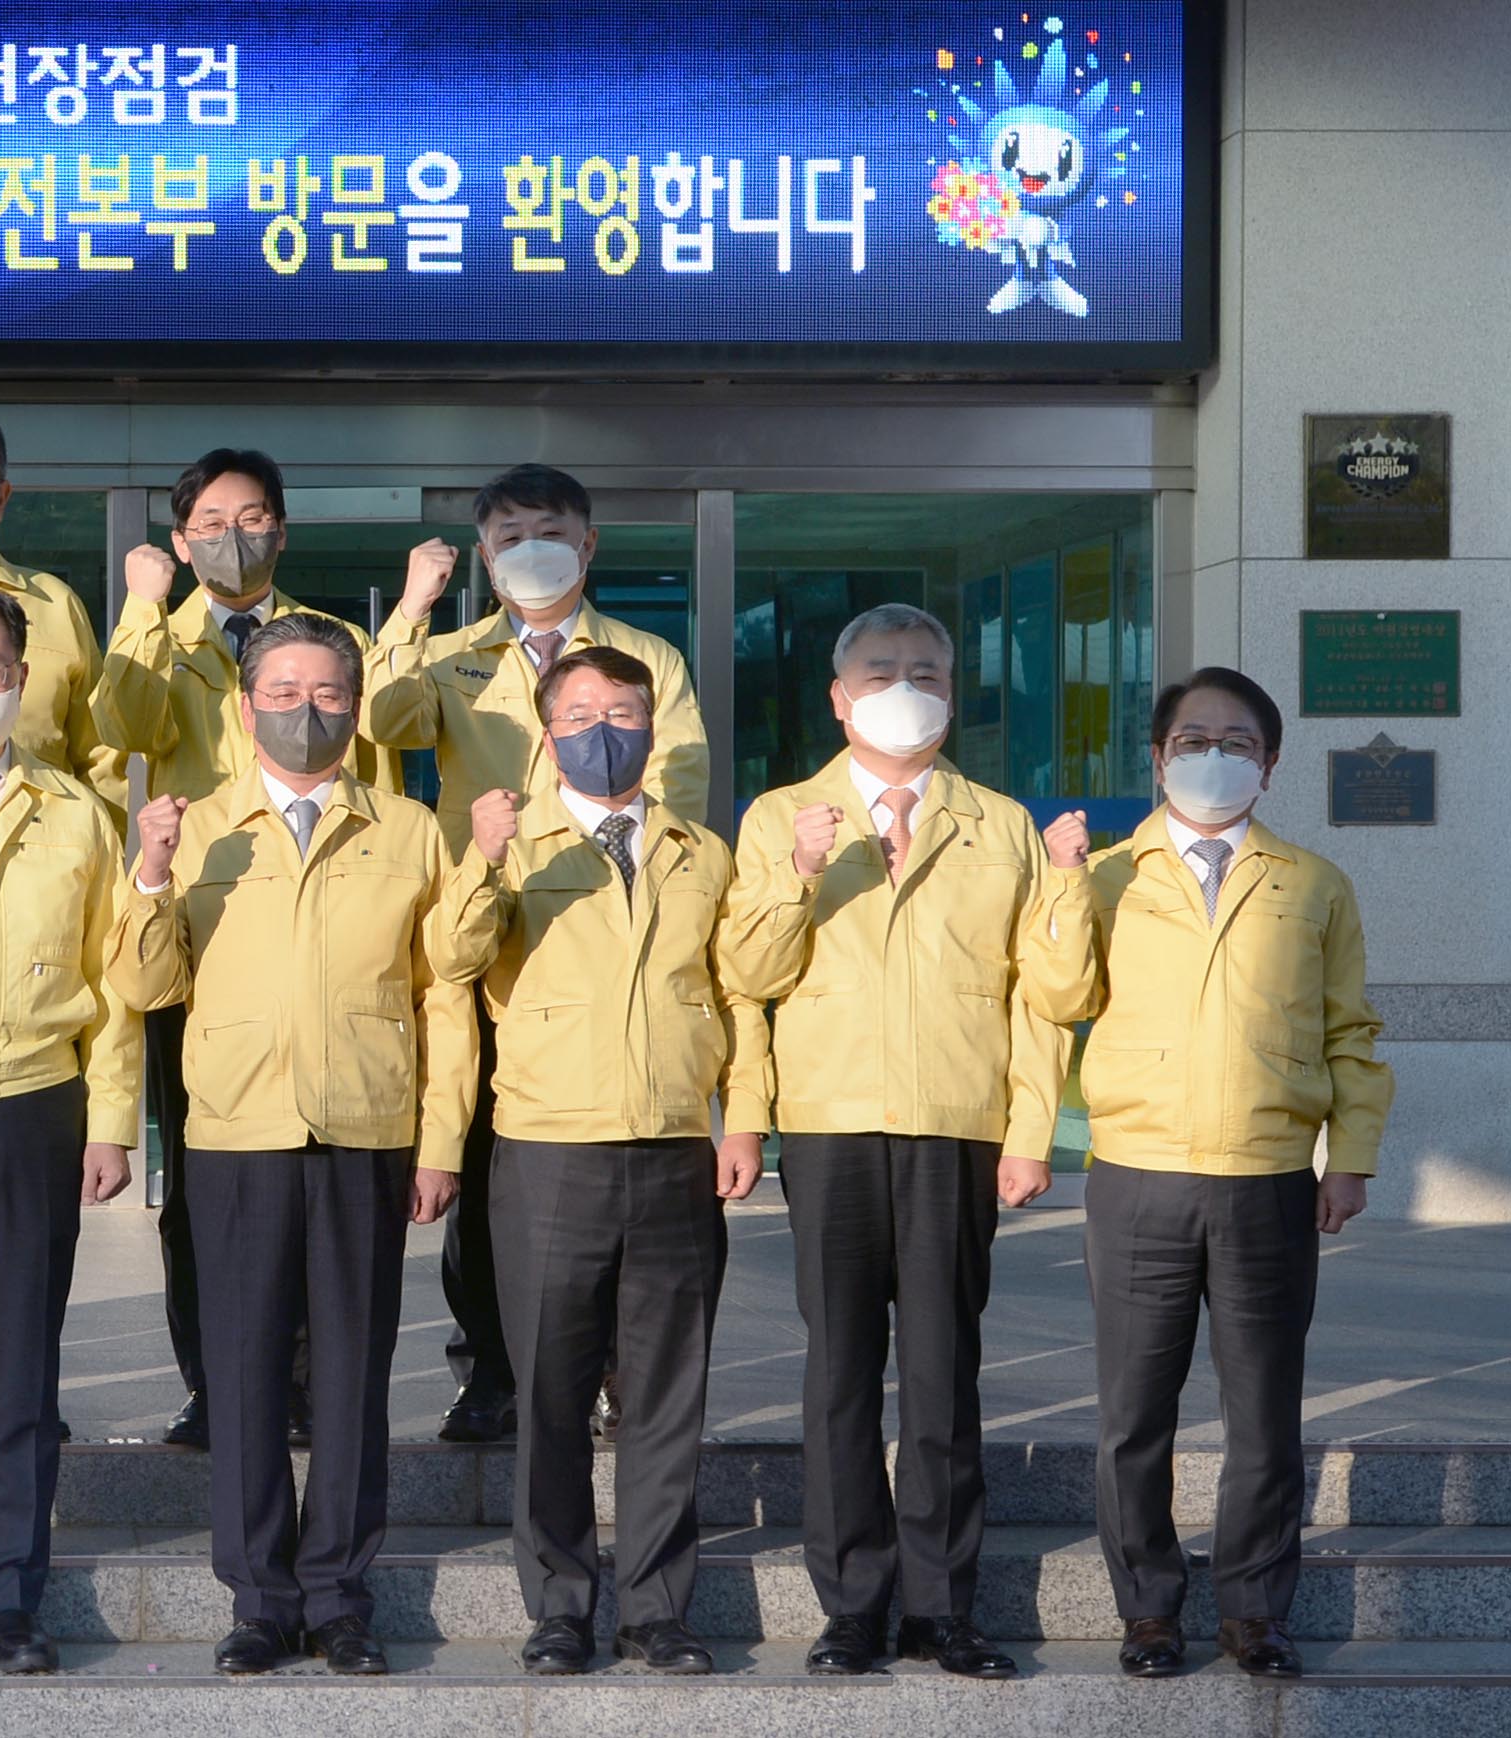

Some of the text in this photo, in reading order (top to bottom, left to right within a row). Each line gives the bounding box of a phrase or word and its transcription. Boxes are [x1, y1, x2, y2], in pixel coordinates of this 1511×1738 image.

[248, 152, 470, 274] 방문을
[503, 152, 876, 275] 환영합니다
[1356, 456, 1400, 467] ENERGY
[1347, 464, 1409, 480] CHAMPION
